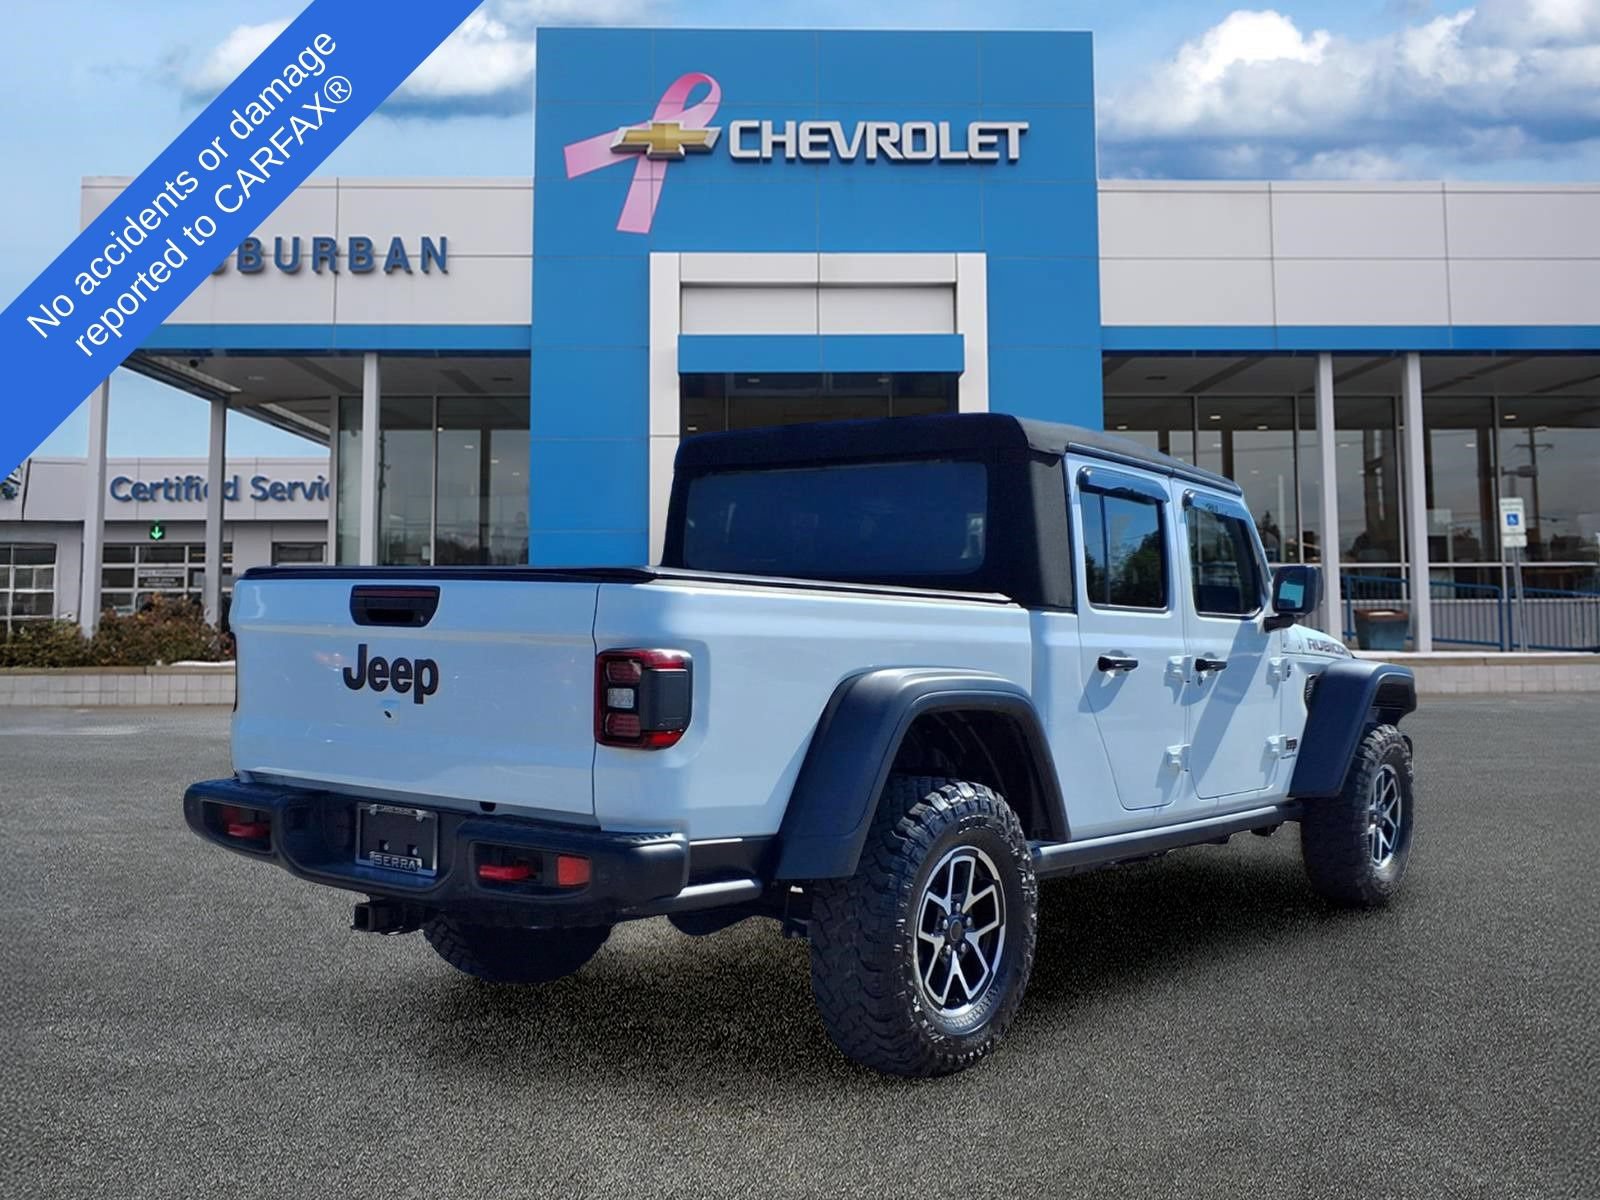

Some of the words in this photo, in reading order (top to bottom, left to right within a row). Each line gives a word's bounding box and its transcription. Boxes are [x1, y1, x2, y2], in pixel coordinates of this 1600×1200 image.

[728, 120, 1030, 163] CHEVROLET
[212, 235, 449, 275] BURBAN
[342, 643, 440, 705] Jeep
[374, 853, 418, 873] SERRA
